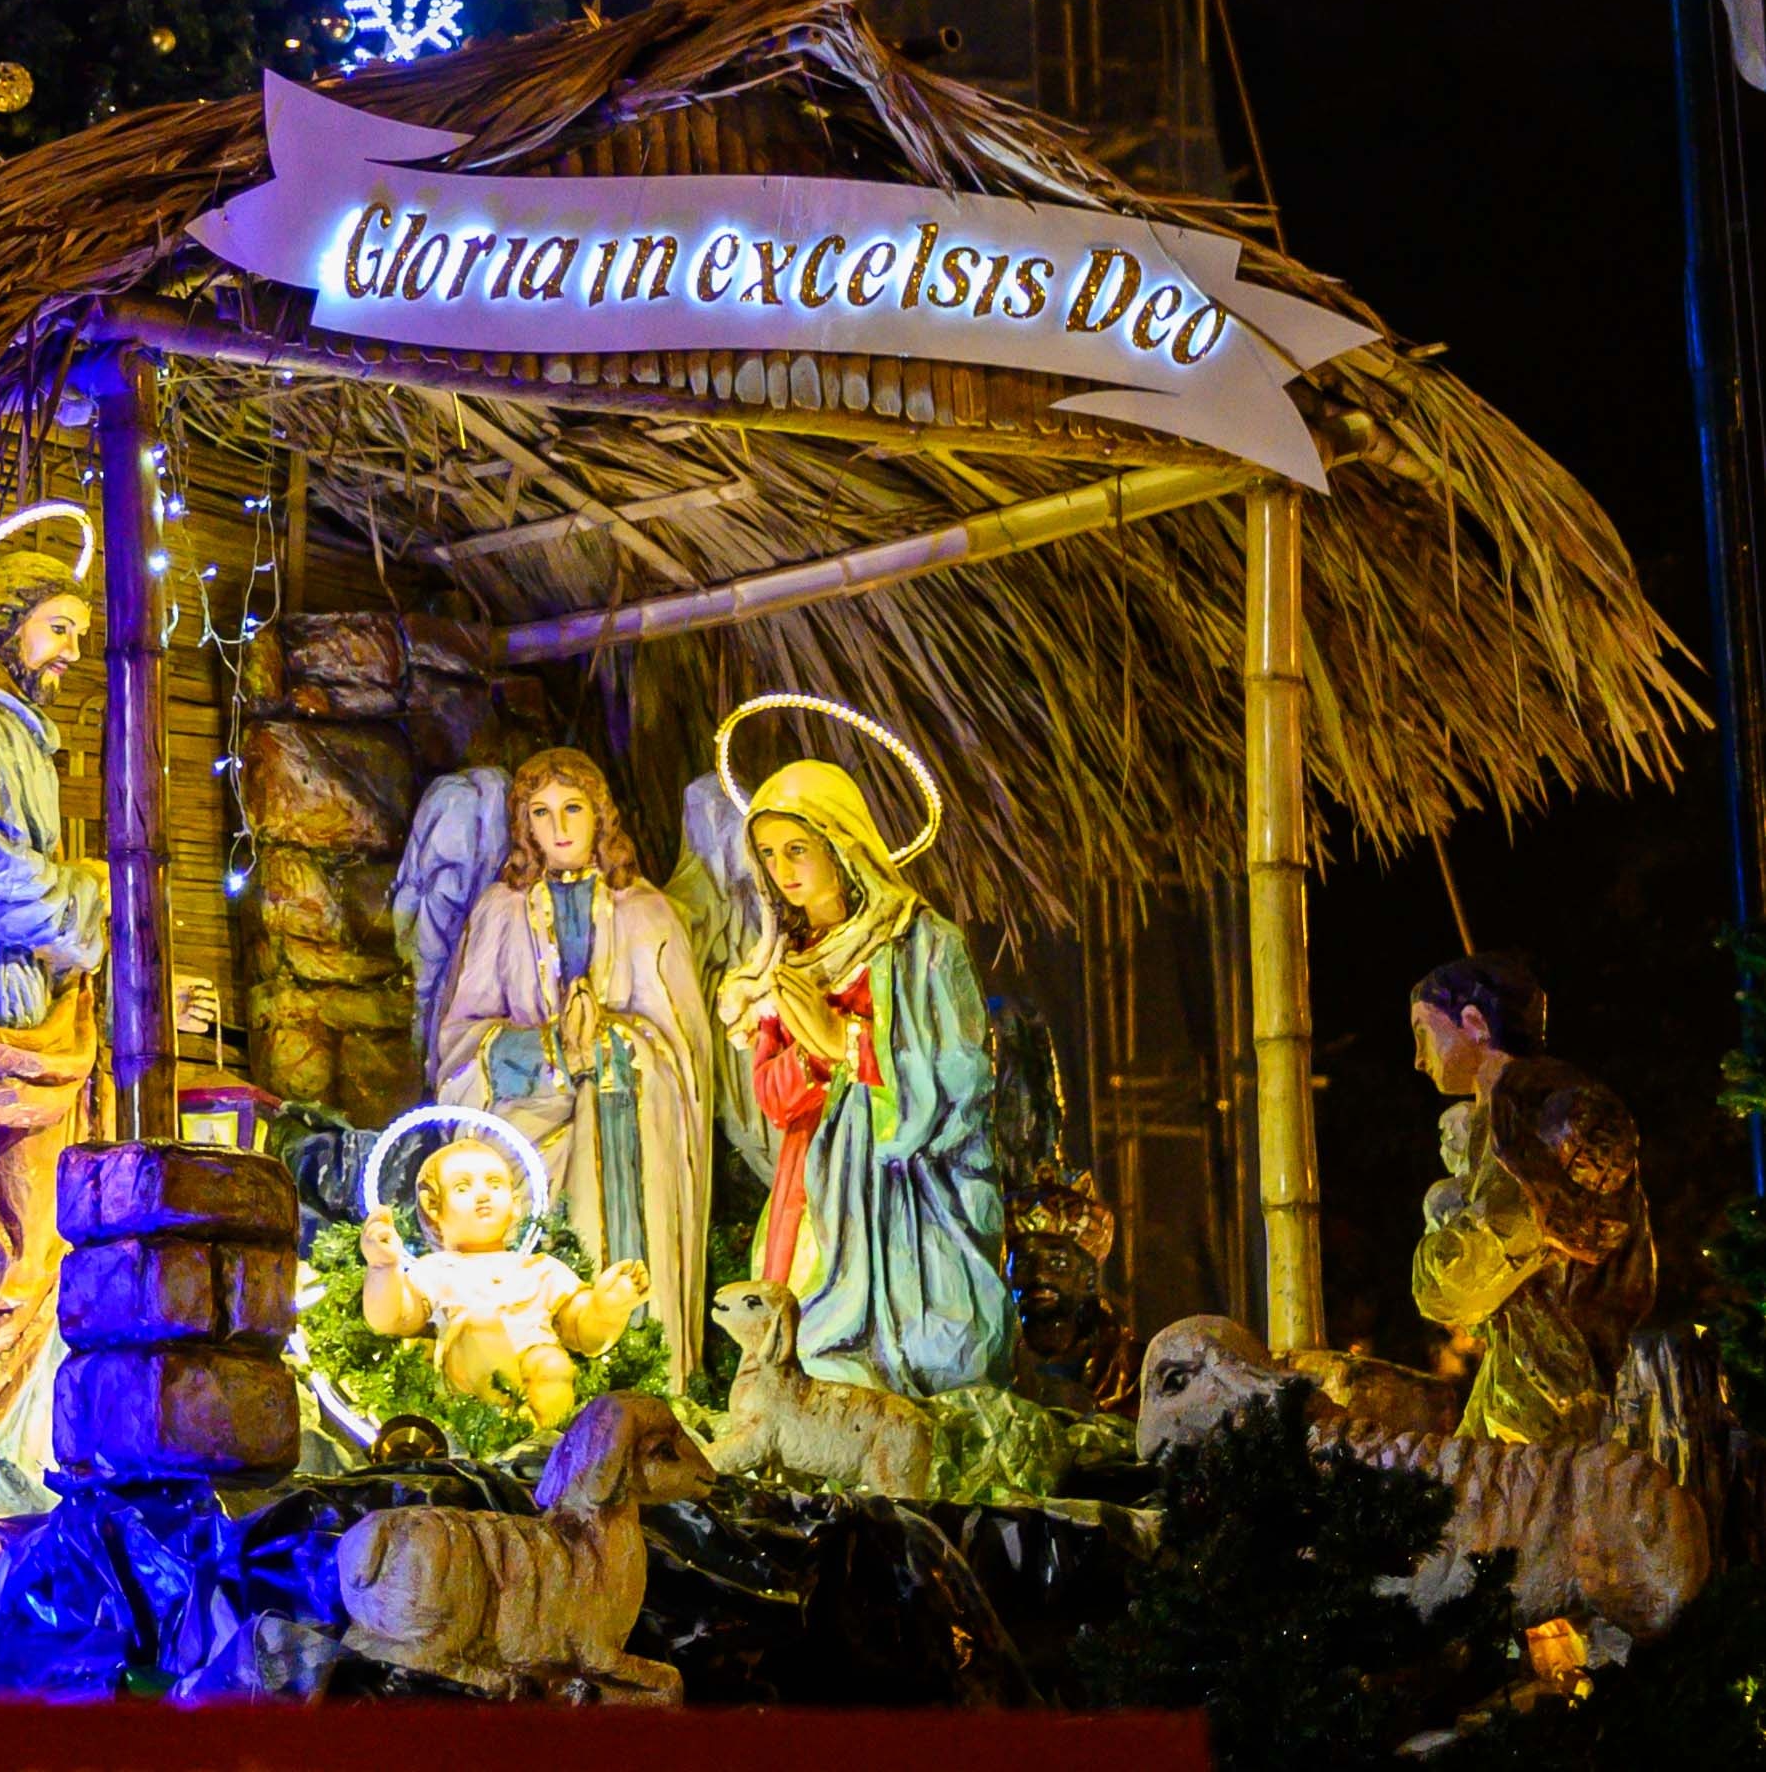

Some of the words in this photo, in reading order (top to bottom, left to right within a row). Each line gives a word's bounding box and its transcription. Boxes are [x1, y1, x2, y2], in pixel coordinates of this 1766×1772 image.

[344, 200, 579, 302] Gloria
[588, 234, 679, 307] in
[696, 222, 1055, 320] excelsis
[1066, 247, 1229, 366] Deo
